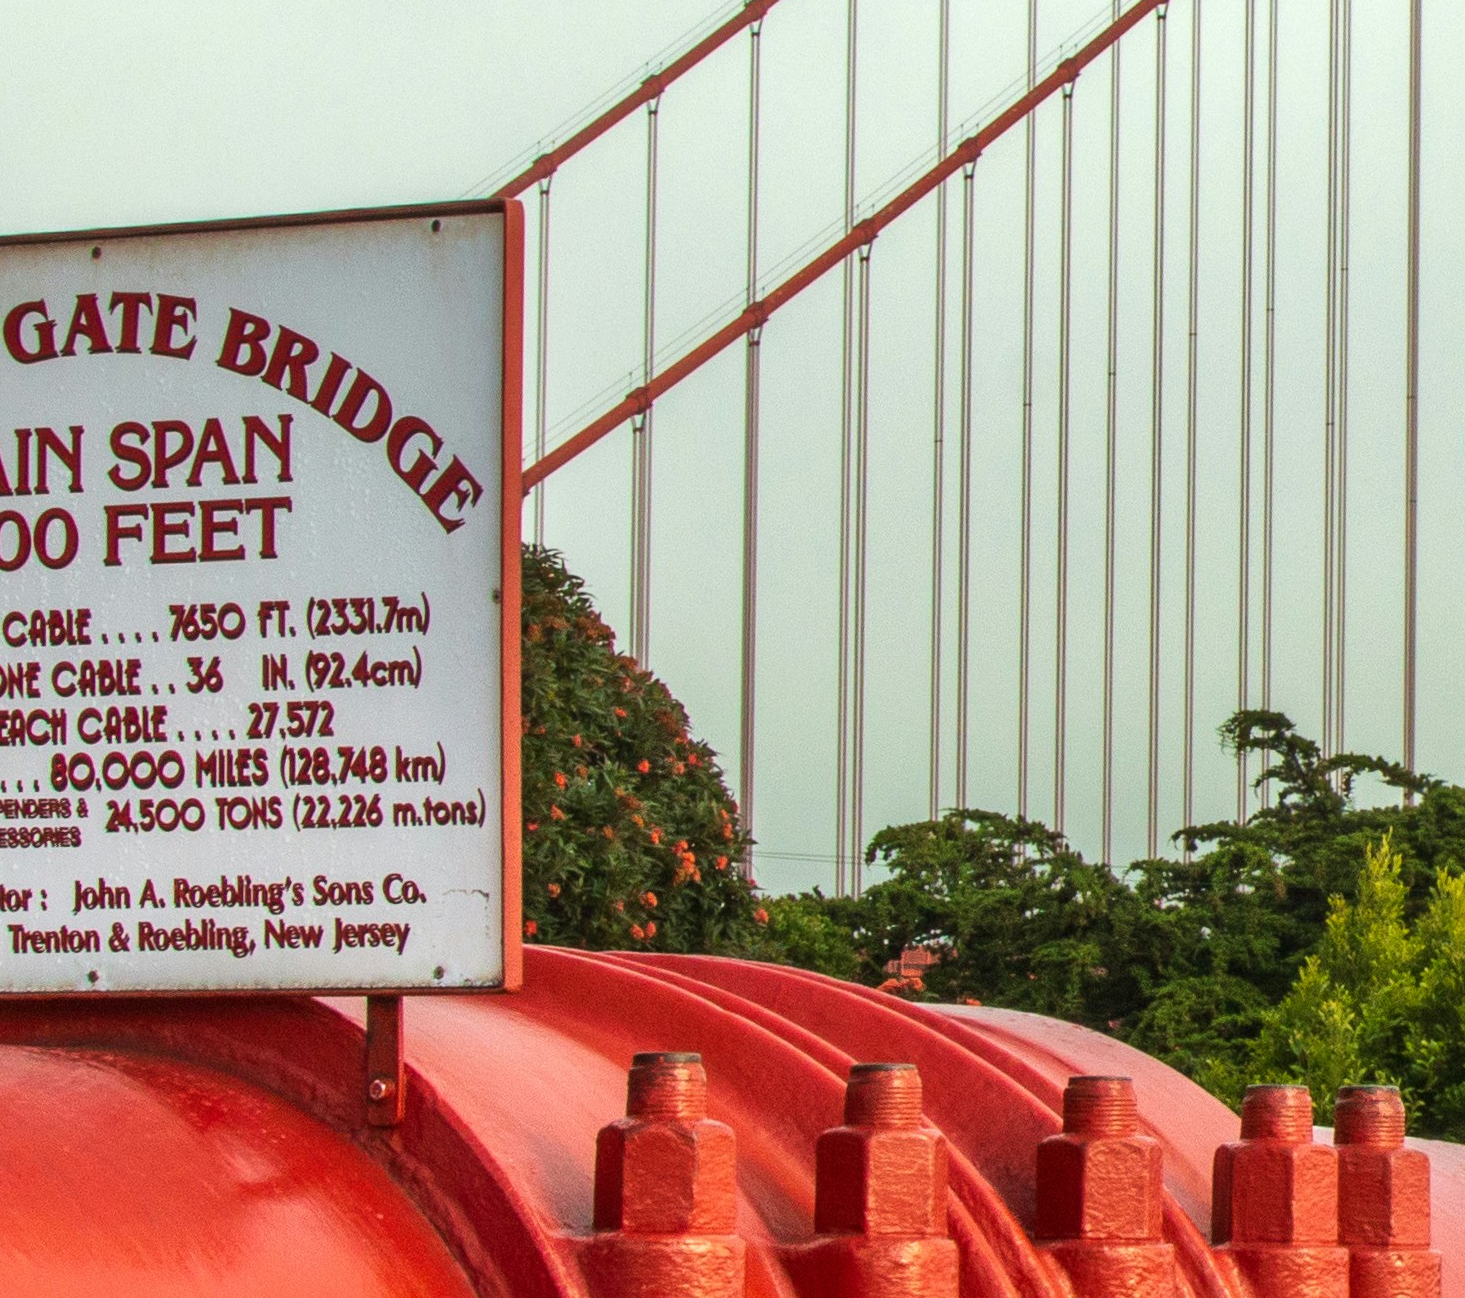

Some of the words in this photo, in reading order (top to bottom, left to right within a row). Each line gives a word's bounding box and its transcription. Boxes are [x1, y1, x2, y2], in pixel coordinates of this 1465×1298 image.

[1, 290, 198, 365] GATE
[215, 306, 485, 535] BRIDGE
[106, 413, 294, 492] SPAN
[102, 495, 293, 567] FEET
[1, 608, 92, 648] CABLE
[168, 602, 247, 642] 7650
[256, 600, 297, 639] FT.
[305, 591, 431, 640] (2331.7m)
[50, 658, 142, 698] CABLE
[185, 656, 224, 694] 36
[261, 653, 296, 692] IN.
[304, 645, 423, 693] (92.4cm)
[76, 705, 168, 745] CABLE
[245, 700, 335, 740] 27,572
[49, 749, 186, 793] 80,000
[195, 747, 270, 789] MILES
[279, 744, 389, 790] (128,748
[394, 741, 446, 786] km)
[75, 797, 89, 819] &
[104, 797, 206, 834] 24,500
[214, 795, 284, 831] TONS
[292, 793, 384, 832] (22,226
[392, 788, 486, 828] m.tons)
[72, 877, 131, 916] John
[138, 878, 166, 909] A.
[173, 874, 305, 916] Roebling's
[312, 874, 374, 907] Sons
[382, 873, 427, 905] Co.
[6, 924, 101, 954] Trenton
[107, 921, 131, 953] &
[137, 918, 257, 959] Roebling,
[263, 918, 324, 950] New
[332, 917, 411, 956] Jersey
